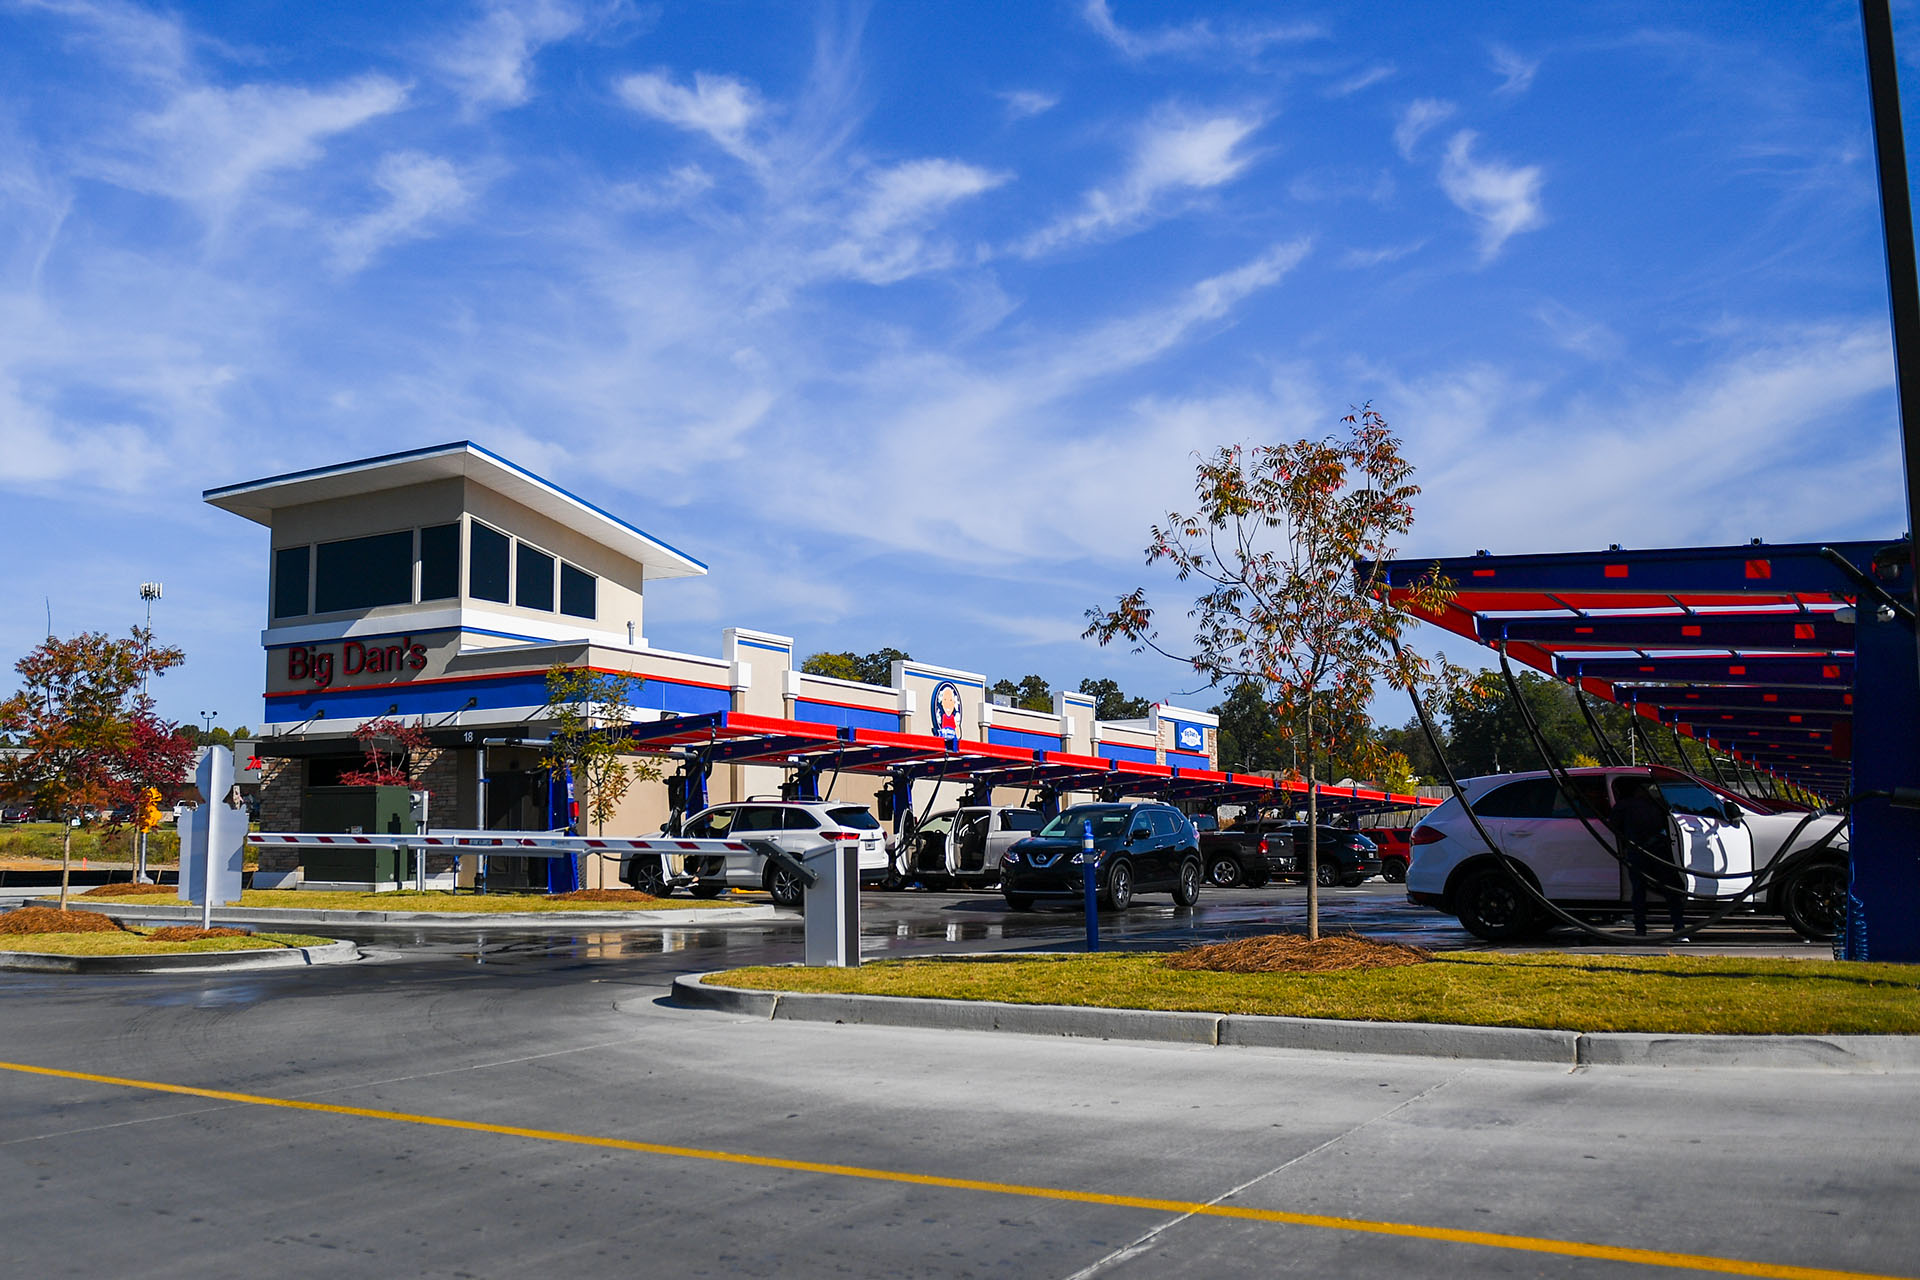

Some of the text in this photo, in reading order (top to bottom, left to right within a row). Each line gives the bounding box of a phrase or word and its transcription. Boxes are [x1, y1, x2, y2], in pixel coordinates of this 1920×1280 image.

[288, 636, 427, 687] Big Dan's
[463, 731, 474, 743] 18
